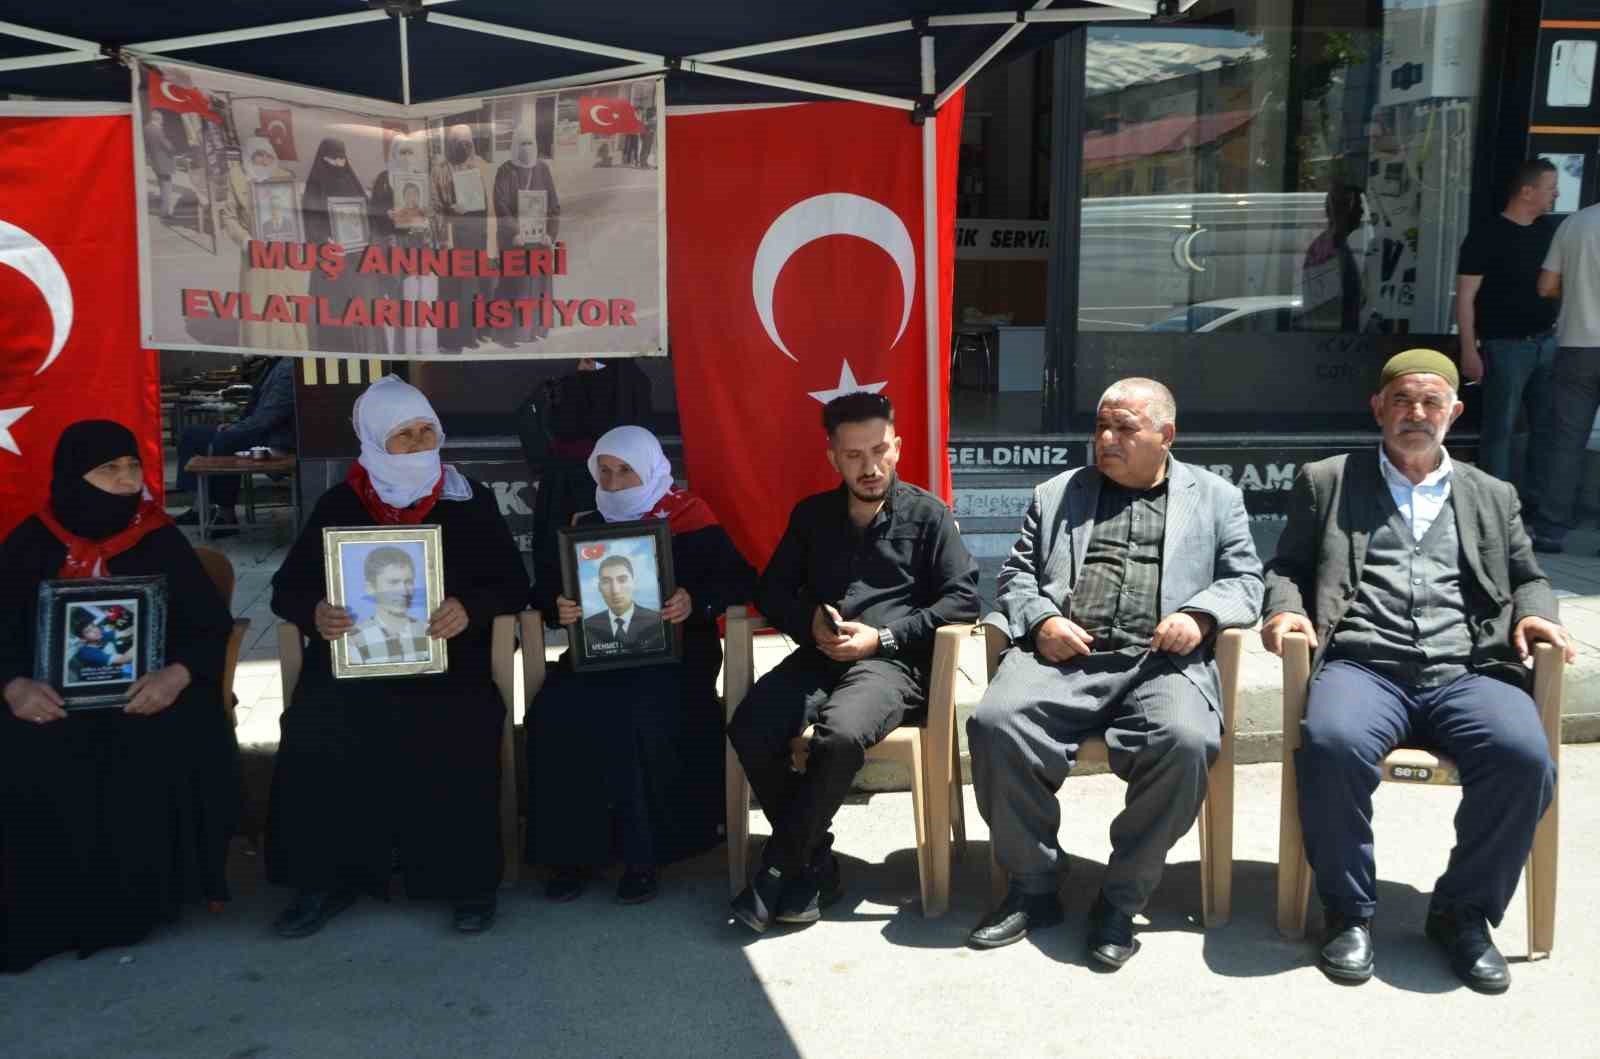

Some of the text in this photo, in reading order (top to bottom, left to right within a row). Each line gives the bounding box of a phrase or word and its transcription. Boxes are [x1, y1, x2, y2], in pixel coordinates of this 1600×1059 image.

[249, 240, 567, 280] MUŞ ANNELERİ
[182, 288, 637, 328] EVLATLARINI İSTİYOR
